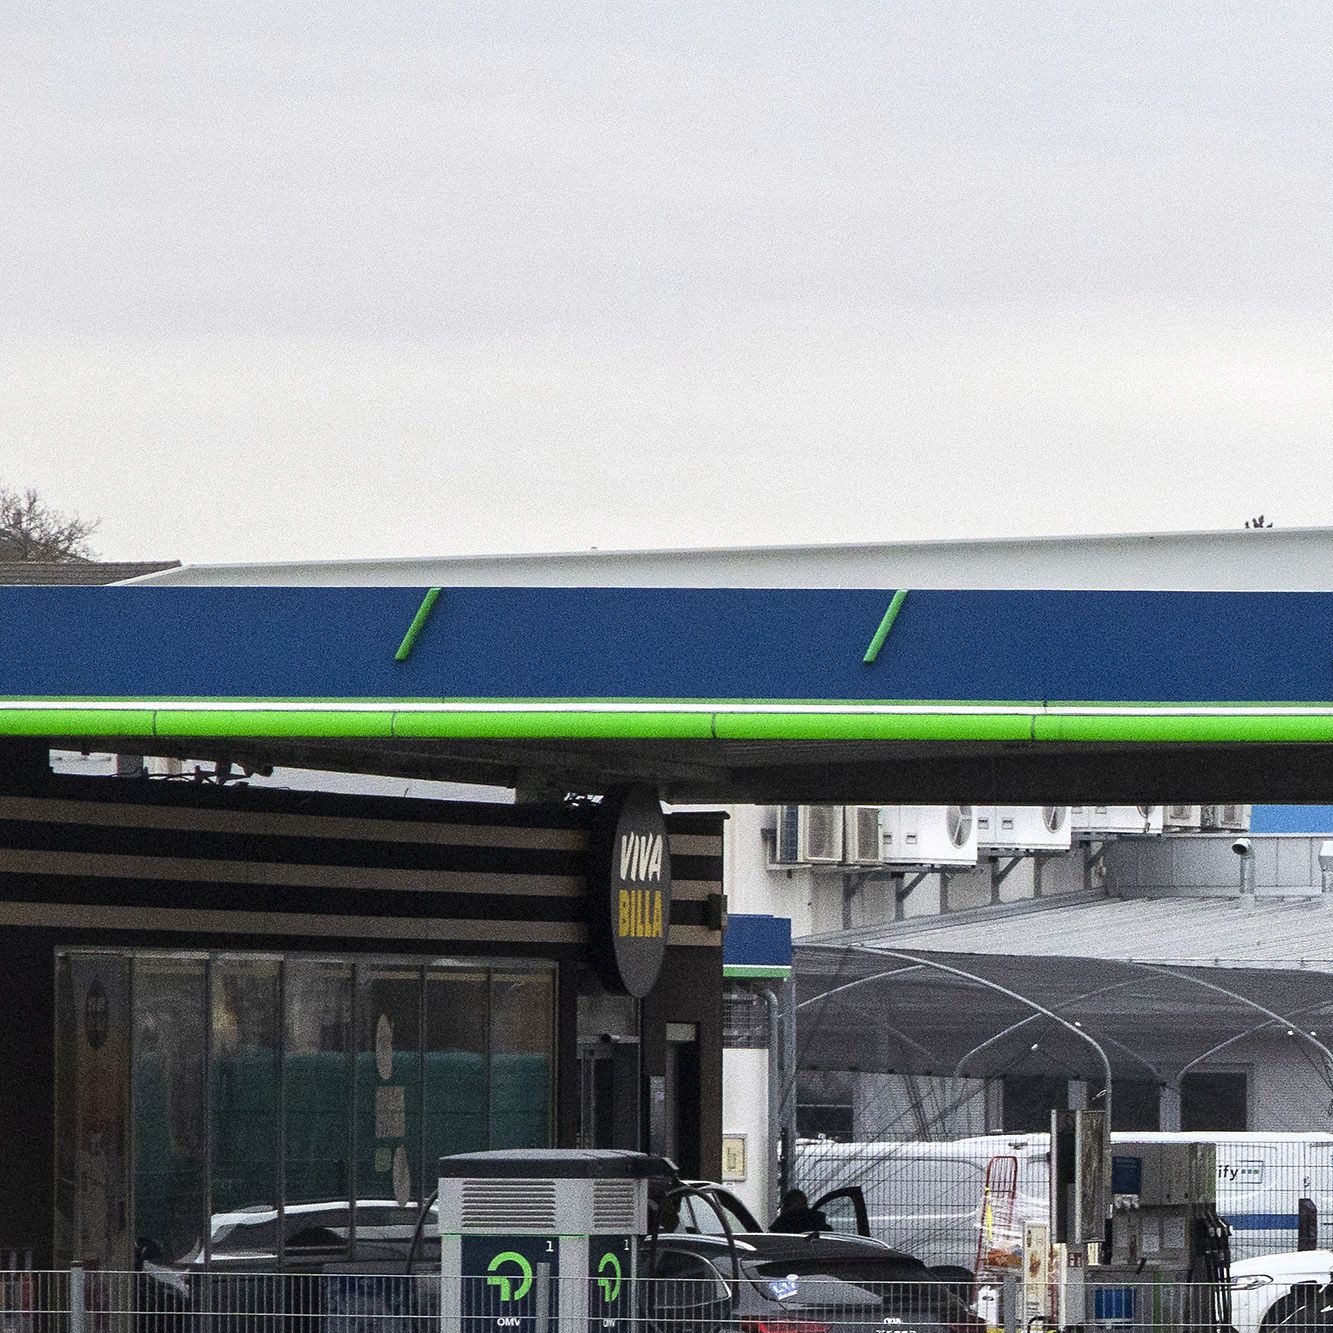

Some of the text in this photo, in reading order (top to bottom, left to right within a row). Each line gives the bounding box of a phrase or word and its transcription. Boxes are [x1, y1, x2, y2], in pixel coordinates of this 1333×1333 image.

[620, 831, 663, 881] VIVA
[618, 889, 662, 938] BILLA
[545, 1240, 554, 1252] 1
